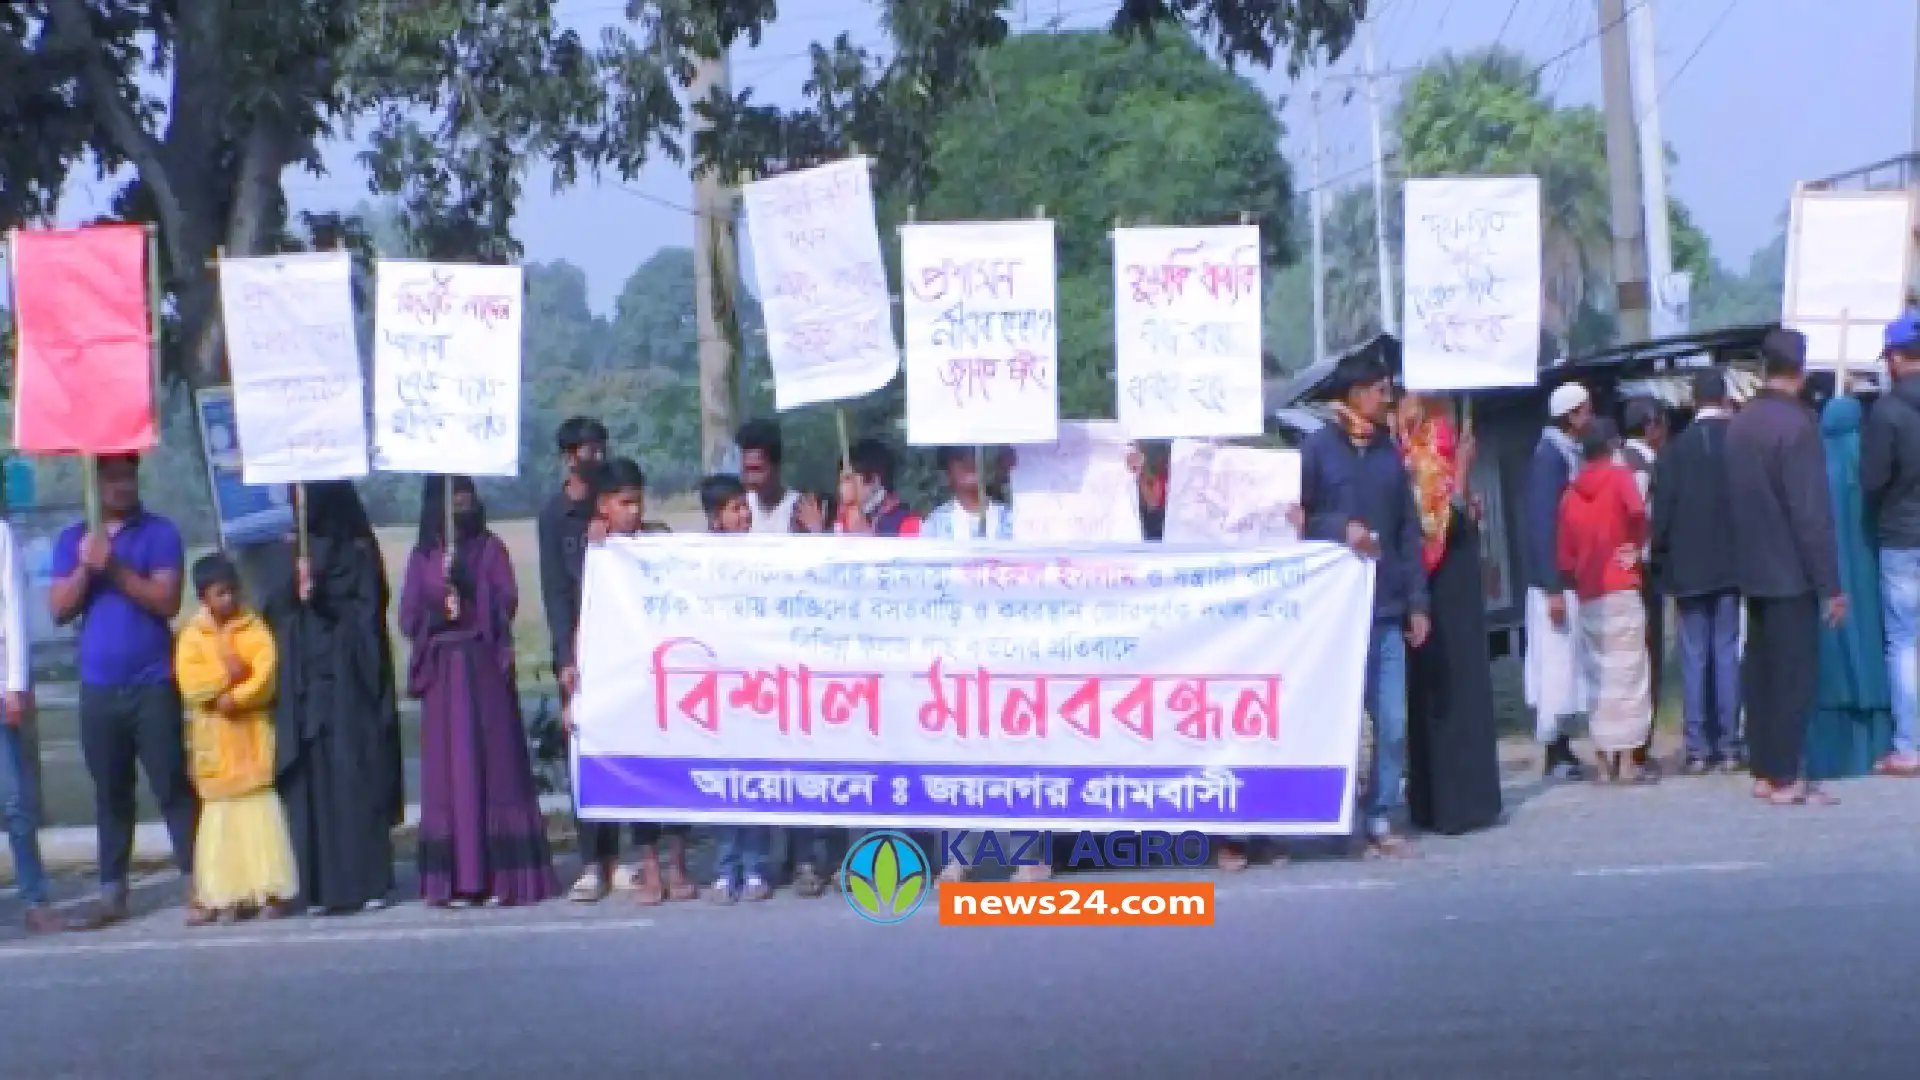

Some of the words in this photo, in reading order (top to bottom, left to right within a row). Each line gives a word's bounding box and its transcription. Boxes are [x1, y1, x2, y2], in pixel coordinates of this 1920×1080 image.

[650, 637, 884, 737] বিশাল
[912, 655, 1283, 741] মানববন্ধন
[690, 768, 879, 805] আয়োজনে
[921, 773, 1074, 809] জয়নগর
[1080, 767, 1245, 813] গ্রামবাসী
